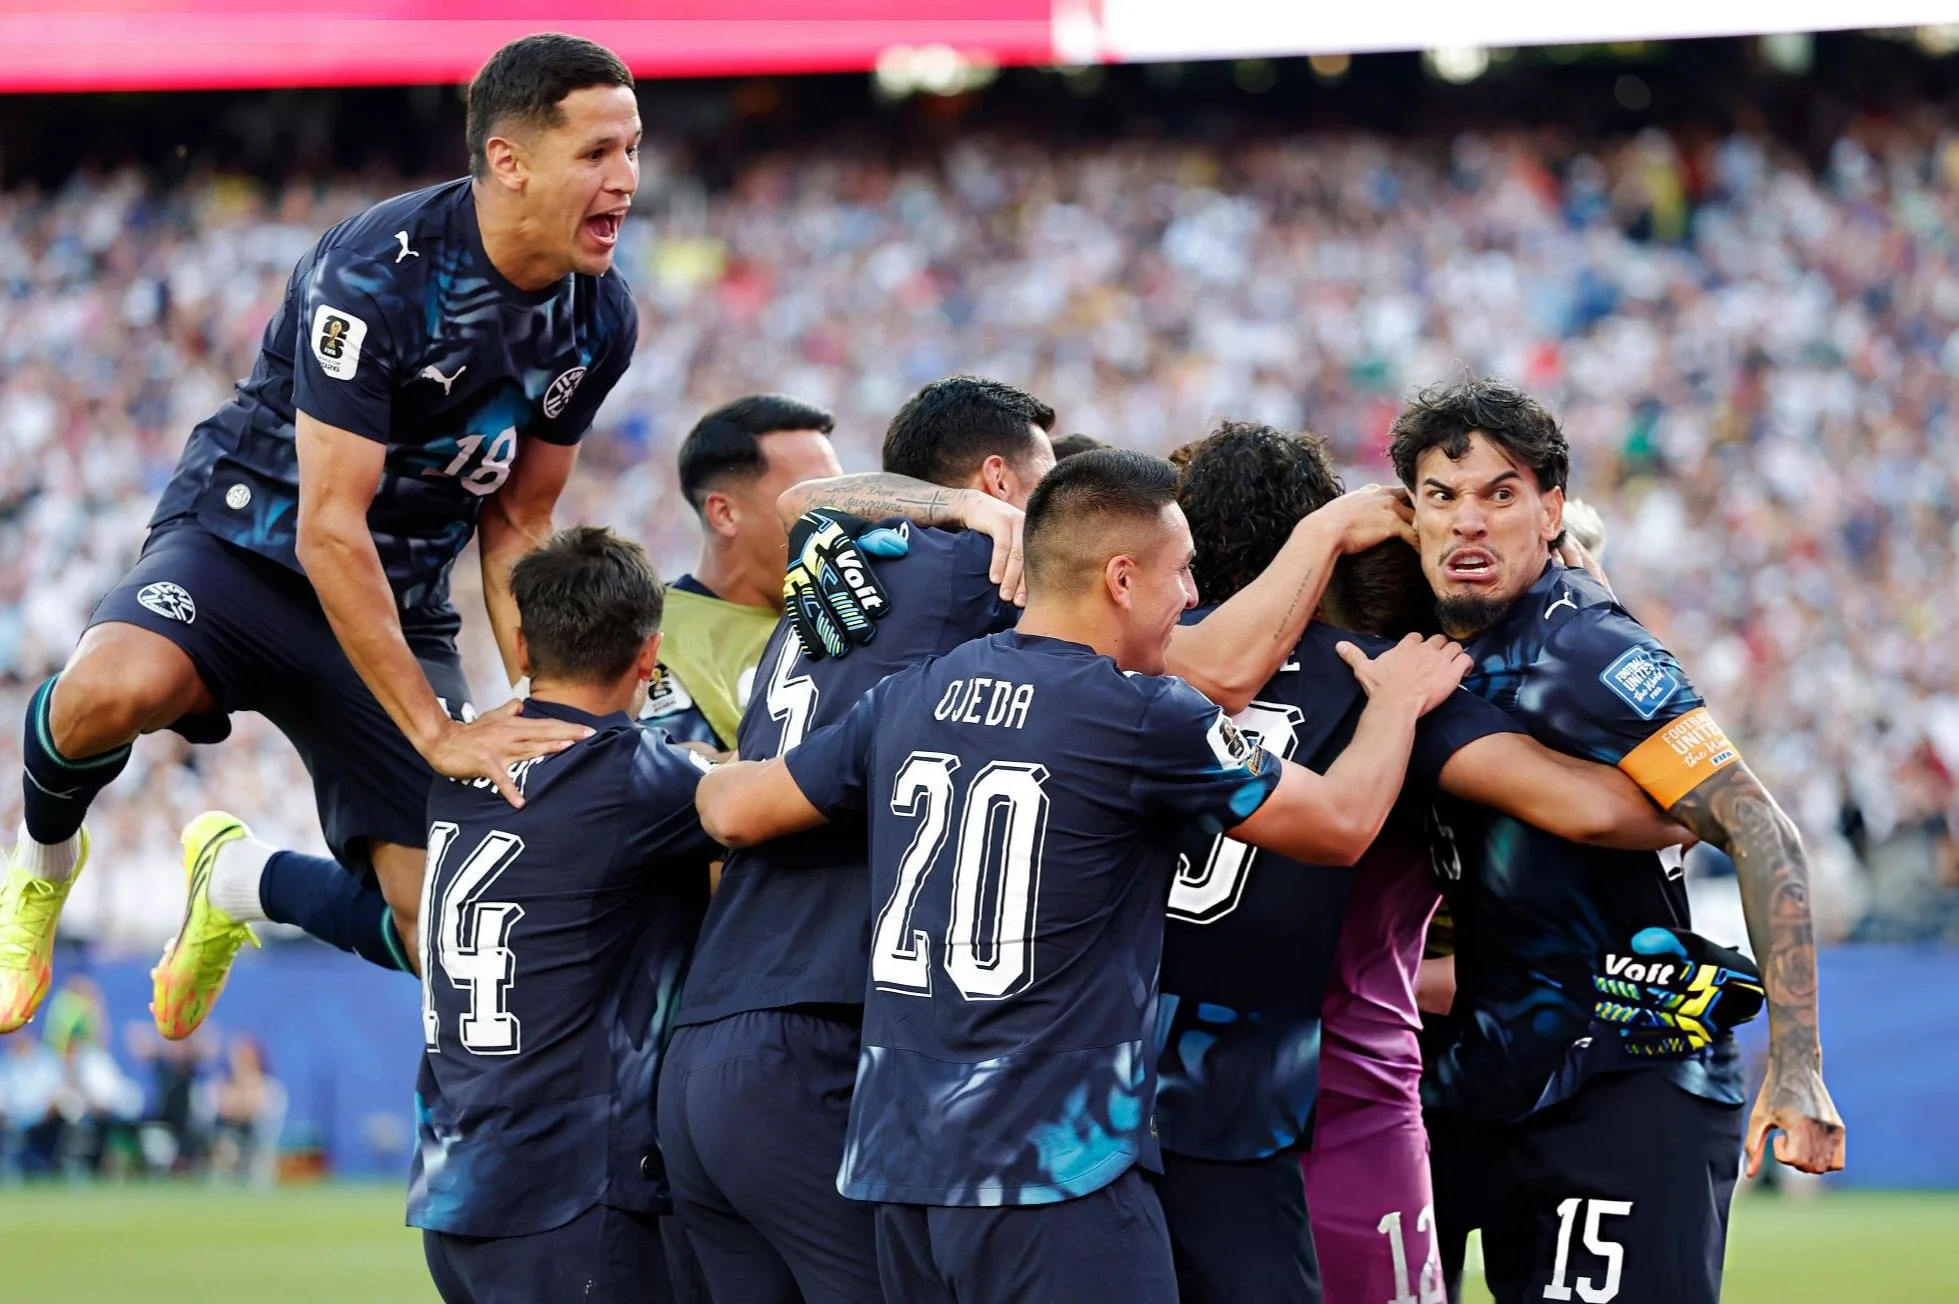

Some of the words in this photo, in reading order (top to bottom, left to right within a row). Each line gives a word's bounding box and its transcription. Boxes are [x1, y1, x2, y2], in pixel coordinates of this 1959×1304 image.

[421, 425, 517, 496] 18
[835, 549, 884, 611] Voit
[1614, 655, 1646, 683] FOOTBALL
[1622, 662, 1655, 692] UNITES
[1633, 687, 1649, 702] the
[1643, 667, 1665, 692] World
[933, 677, 1035, 729] OJEDA
[1649, 686, 1664, 700] FIFA
[1682, 750, 1708, 769] the
[1713, 751, 1733, 764] FIFA
[873, 750, 1051, 1001] 20
[417, 820, 525, 1055] 14
[1605, 953, 1676, 985] Voit
[1542, 1198, 1634, 1304] 15
